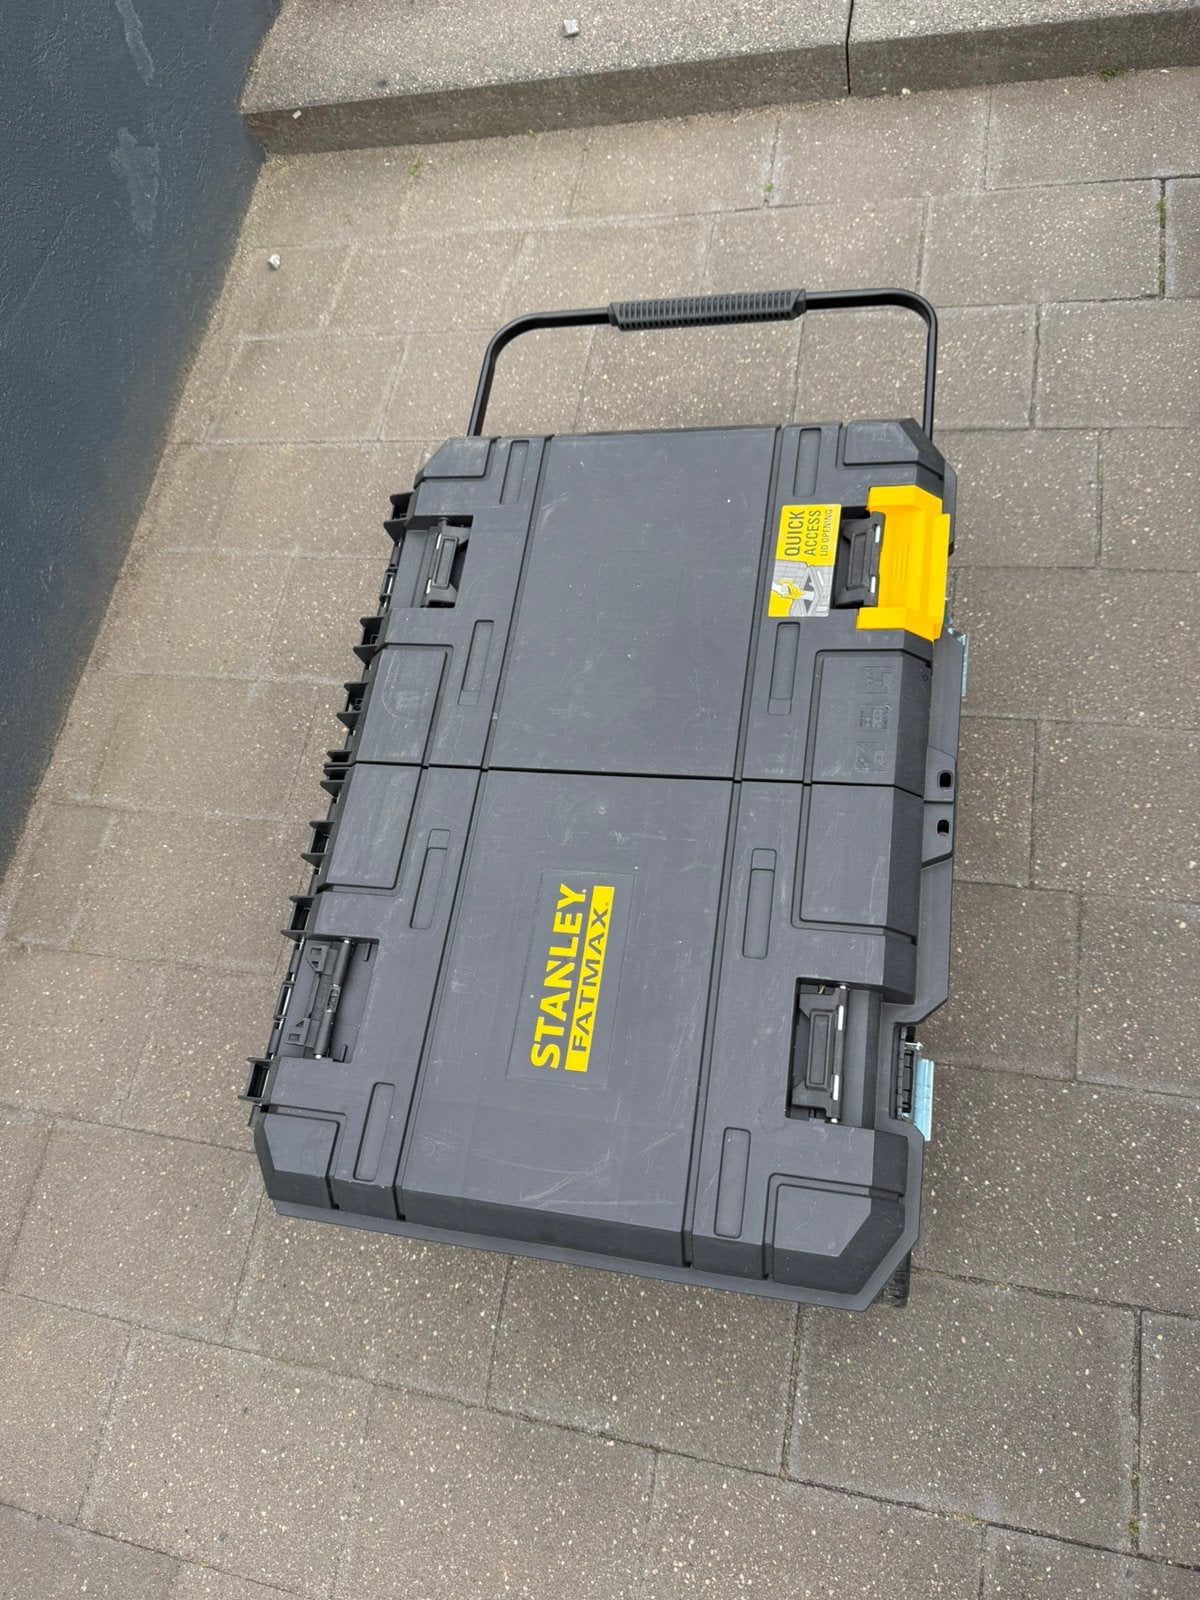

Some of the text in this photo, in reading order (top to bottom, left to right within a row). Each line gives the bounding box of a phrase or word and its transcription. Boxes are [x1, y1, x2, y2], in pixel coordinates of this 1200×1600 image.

[784, 510, 805, 556] QUICK
[804, 510, 821, 556] ACCESS
[820, 509, 833, 557] LID OPENING
[530, 883, 586, 1069] STANLEY
[571, 907, 609, 1052] FATMAX
